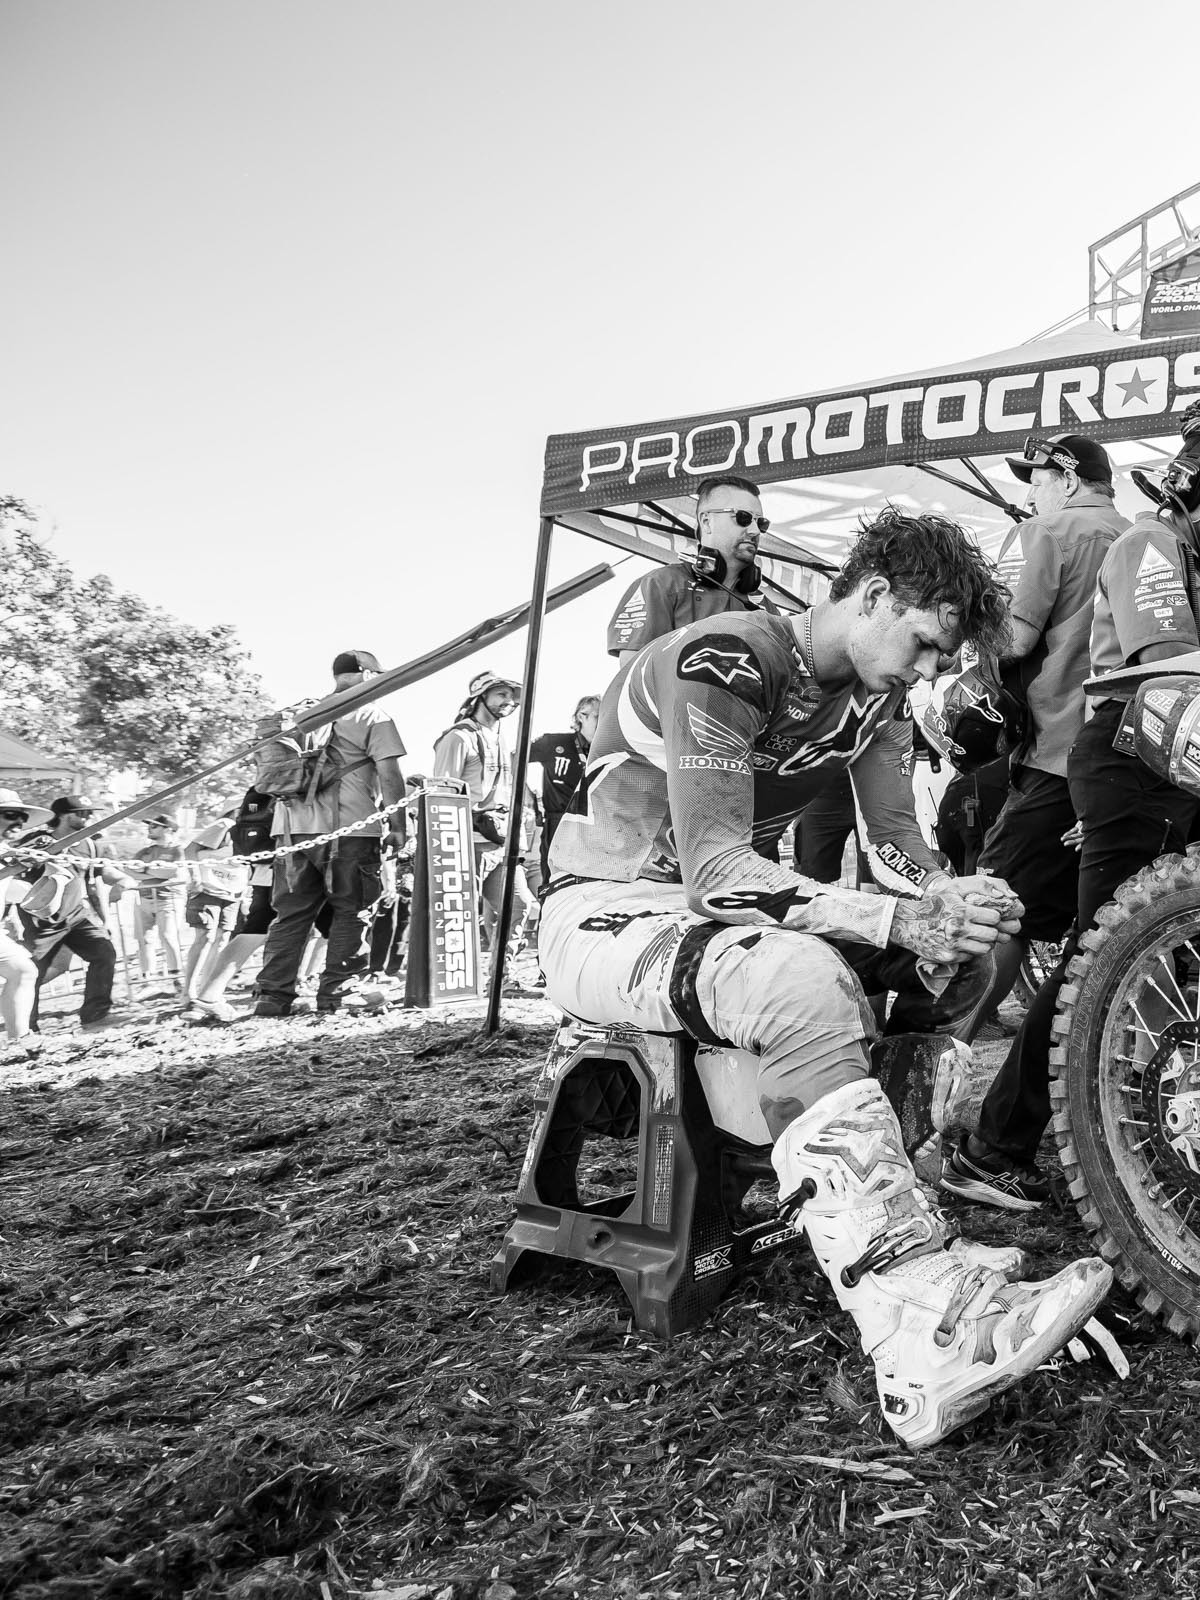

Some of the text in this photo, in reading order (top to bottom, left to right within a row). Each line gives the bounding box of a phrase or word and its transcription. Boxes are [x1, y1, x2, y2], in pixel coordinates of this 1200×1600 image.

[1150, 304, 1181, 314] WORLD
[679, 755, 752, 775] HONDA
[876, 842, 927, 887] HONDA
[429, 804, 447, 992] CHAMPIONSHIP
[438, 804, 467, 991] MOTOCROSS
[461, 872, 472, 920] PRO
